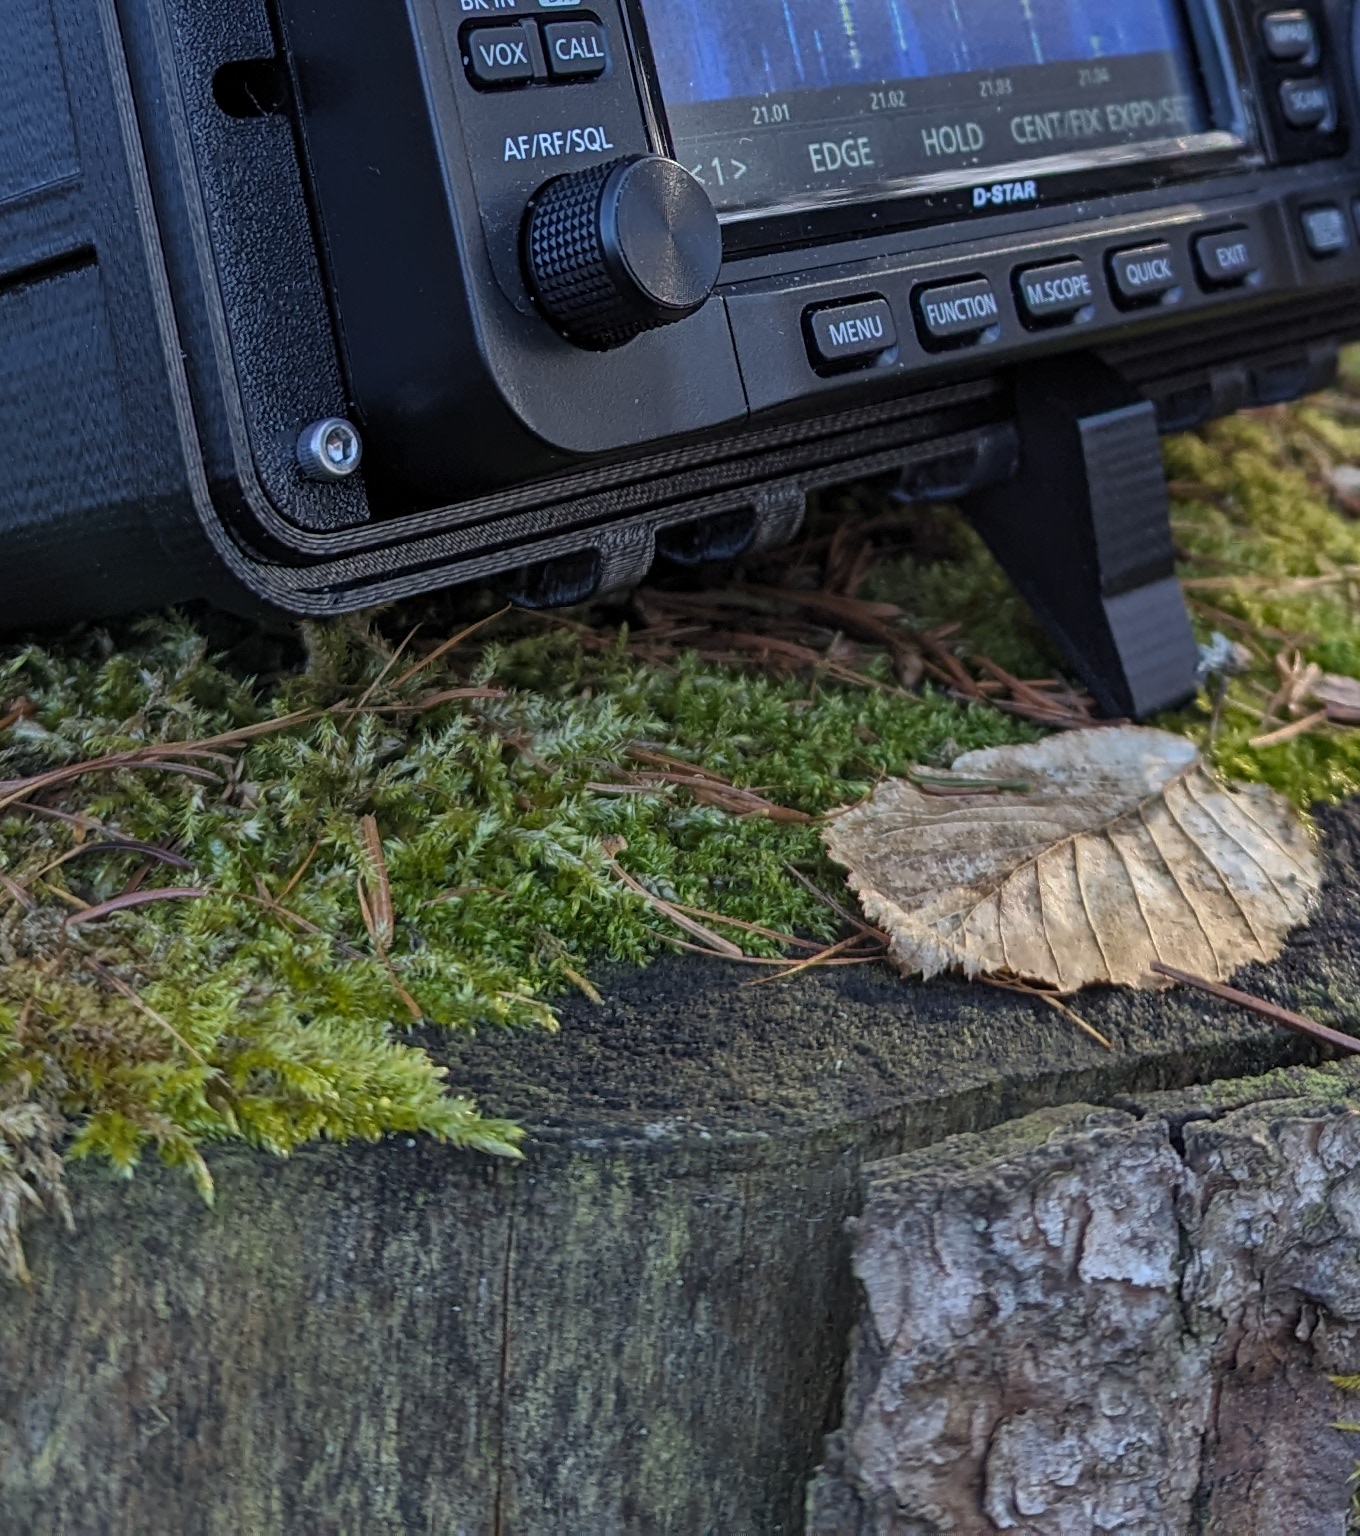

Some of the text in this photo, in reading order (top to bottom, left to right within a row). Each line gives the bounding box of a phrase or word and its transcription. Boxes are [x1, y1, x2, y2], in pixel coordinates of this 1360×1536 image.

[479, 36, 604, 67] VOX CALL
[752, 104, 790, 125] 21.01
[870, 90, 906, 110] 21.02
[503, 126, 614, 162] AF/RF/SQL
[808, 137, 874, 173] EDGE
[922, 123, 984, 157] HOLD
[1011, 107, 1103, 144] CENT/FIX
[973, 180, 1036, 207] D-STAR
[829, 244, 1248, 345] MENU FUNCTION M.SCOPE QUICK EXIT
